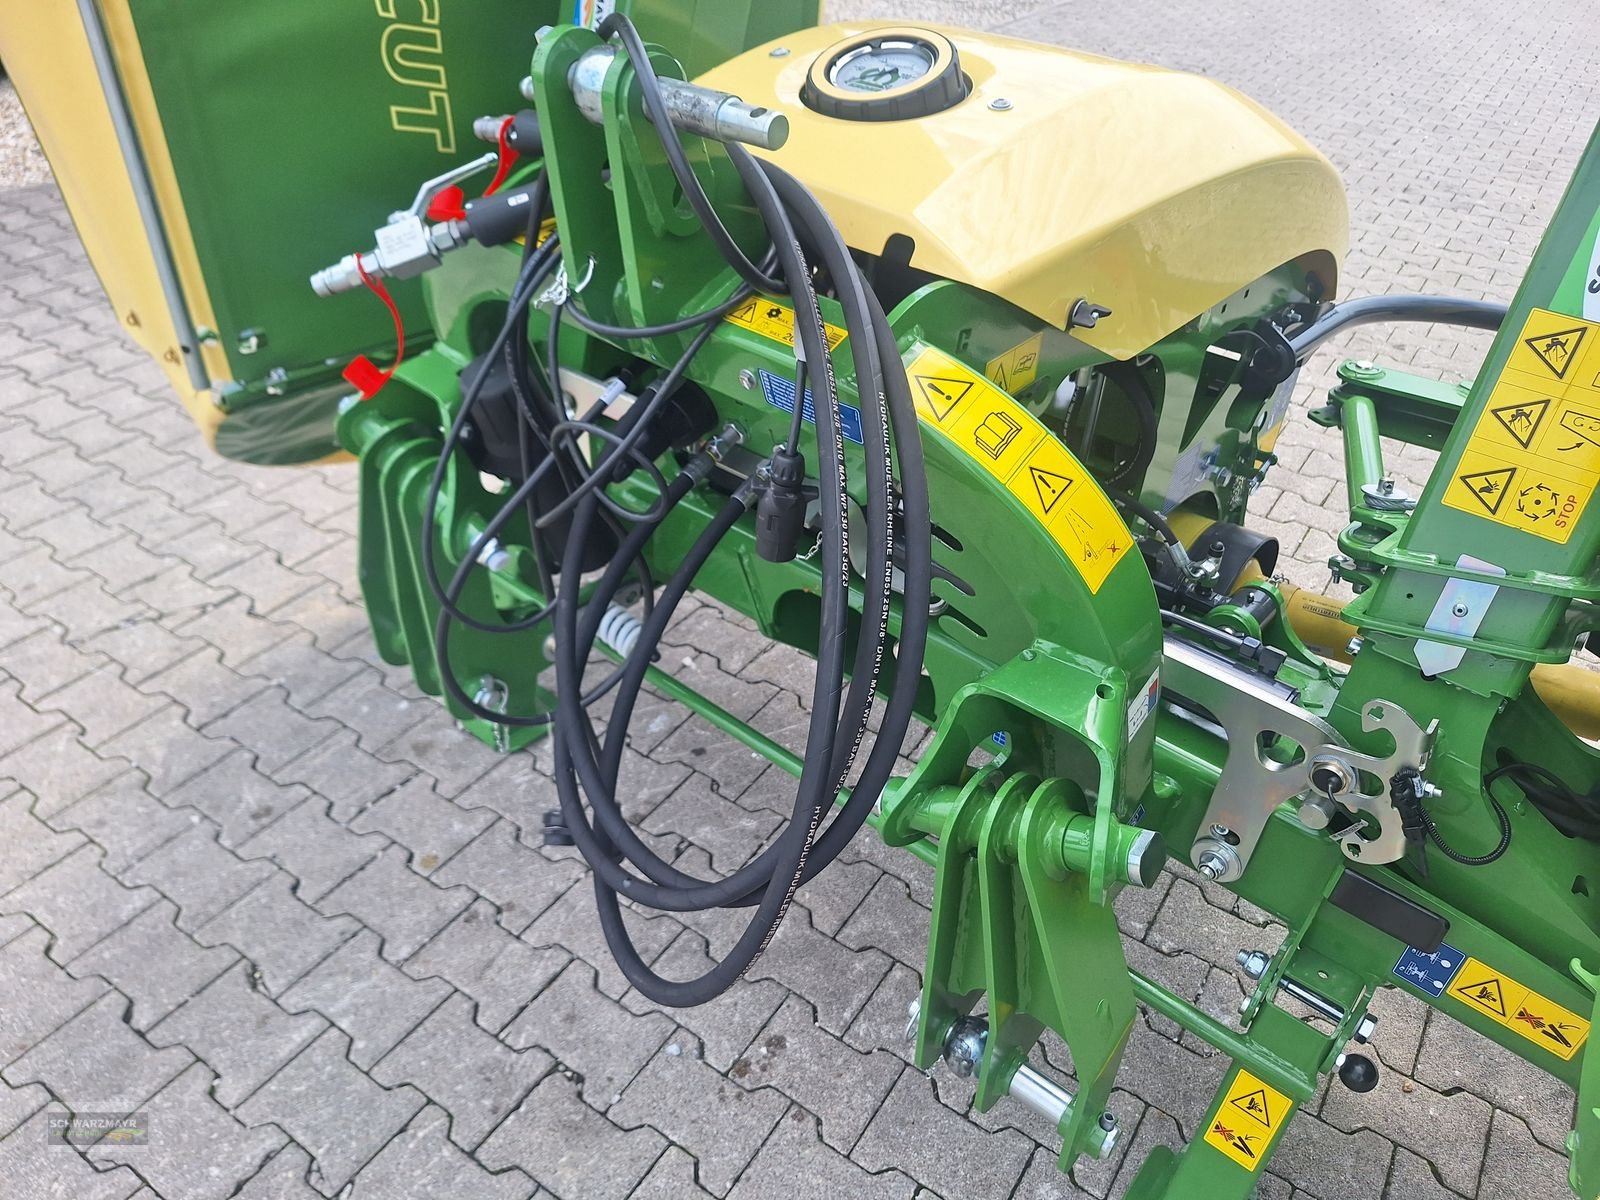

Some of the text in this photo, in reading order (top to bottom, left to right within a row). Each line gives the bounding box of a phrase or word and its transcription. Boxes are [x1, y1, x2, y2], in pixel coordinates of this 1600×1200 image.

[809, 285, 823, 328] MUELLER
[819, 326, 831, 360] RHEINE
[826, 362, 836, 392] EN853
[836, 434, 844, 460] DN10
[840, 493, 848, 510] WP
[878, 391, 890, 455] HYDRAULIK
[884, 457, 893, 511] MUELLER
[1555, 494, 1578, 529] STOP
[886, 512, 894, 556] RHEINE
[884, 561, 892, 596] EN853
[881, 598, 890, 619] 2SN
[873, 646, 884, 674] DN10
[861, 706, 871, 726] WP
[854, 726, 864, 746] 330
[847, 745, 860, 769] BAR
[799, 805, 822, 870] HYDRAULIK
[779, 869, 804, 917] MUELLER
